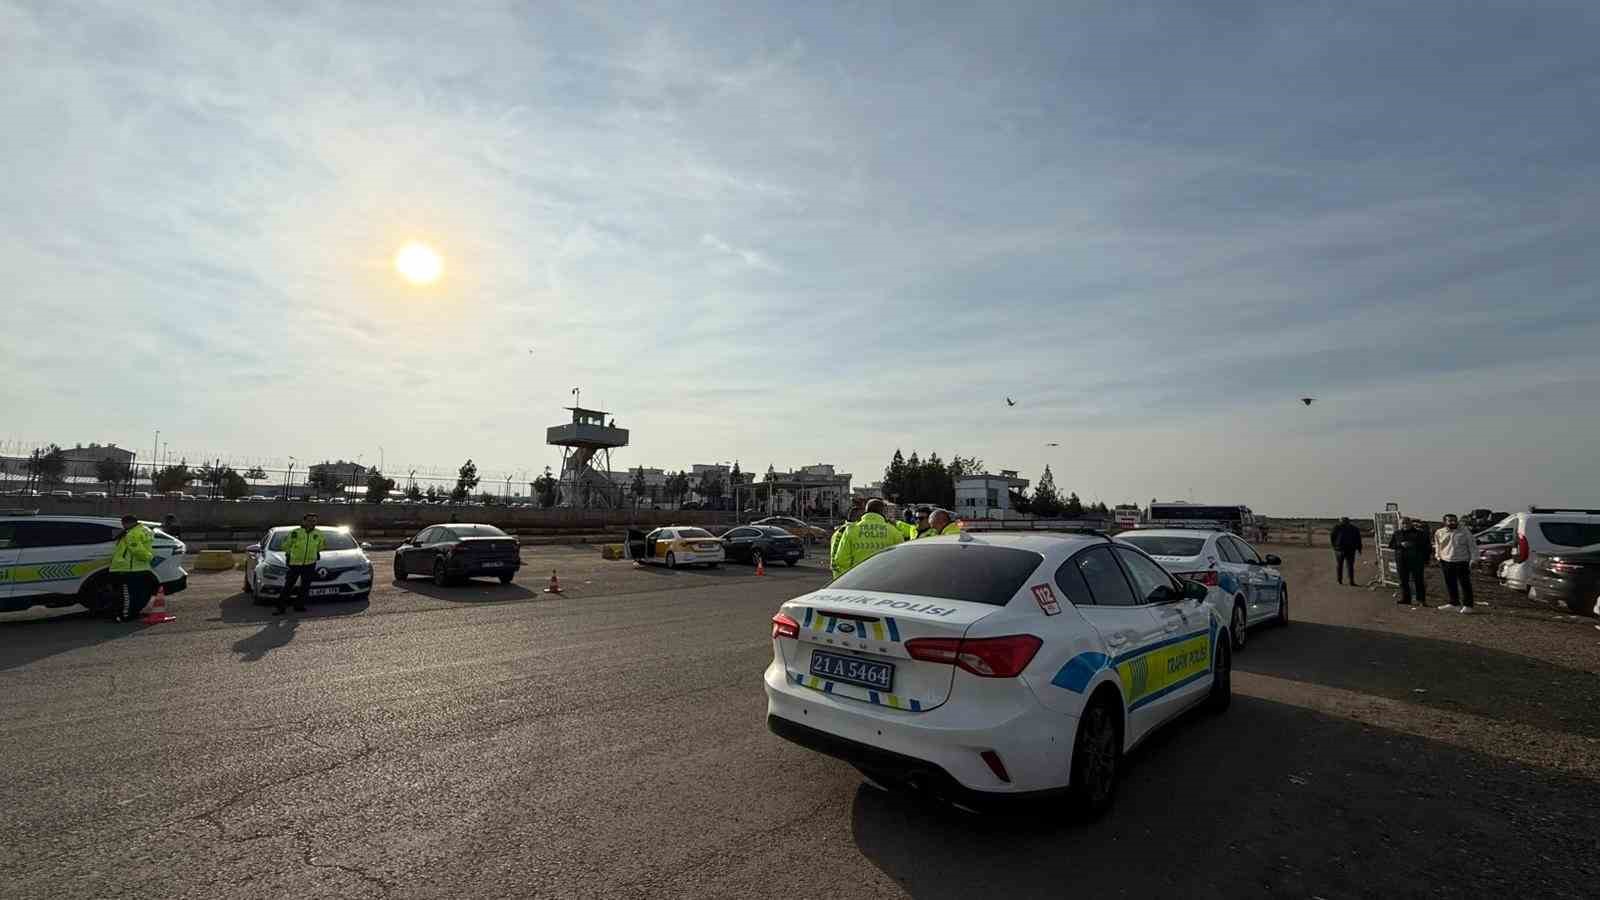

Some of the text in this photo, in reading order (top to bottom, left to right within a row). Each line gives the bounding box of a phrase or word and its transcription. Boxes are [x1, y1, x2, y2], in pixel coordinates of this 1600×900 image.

[1034, 586, 1055, 602] 112
[813, 655, 889, 684] 21 A 5464
